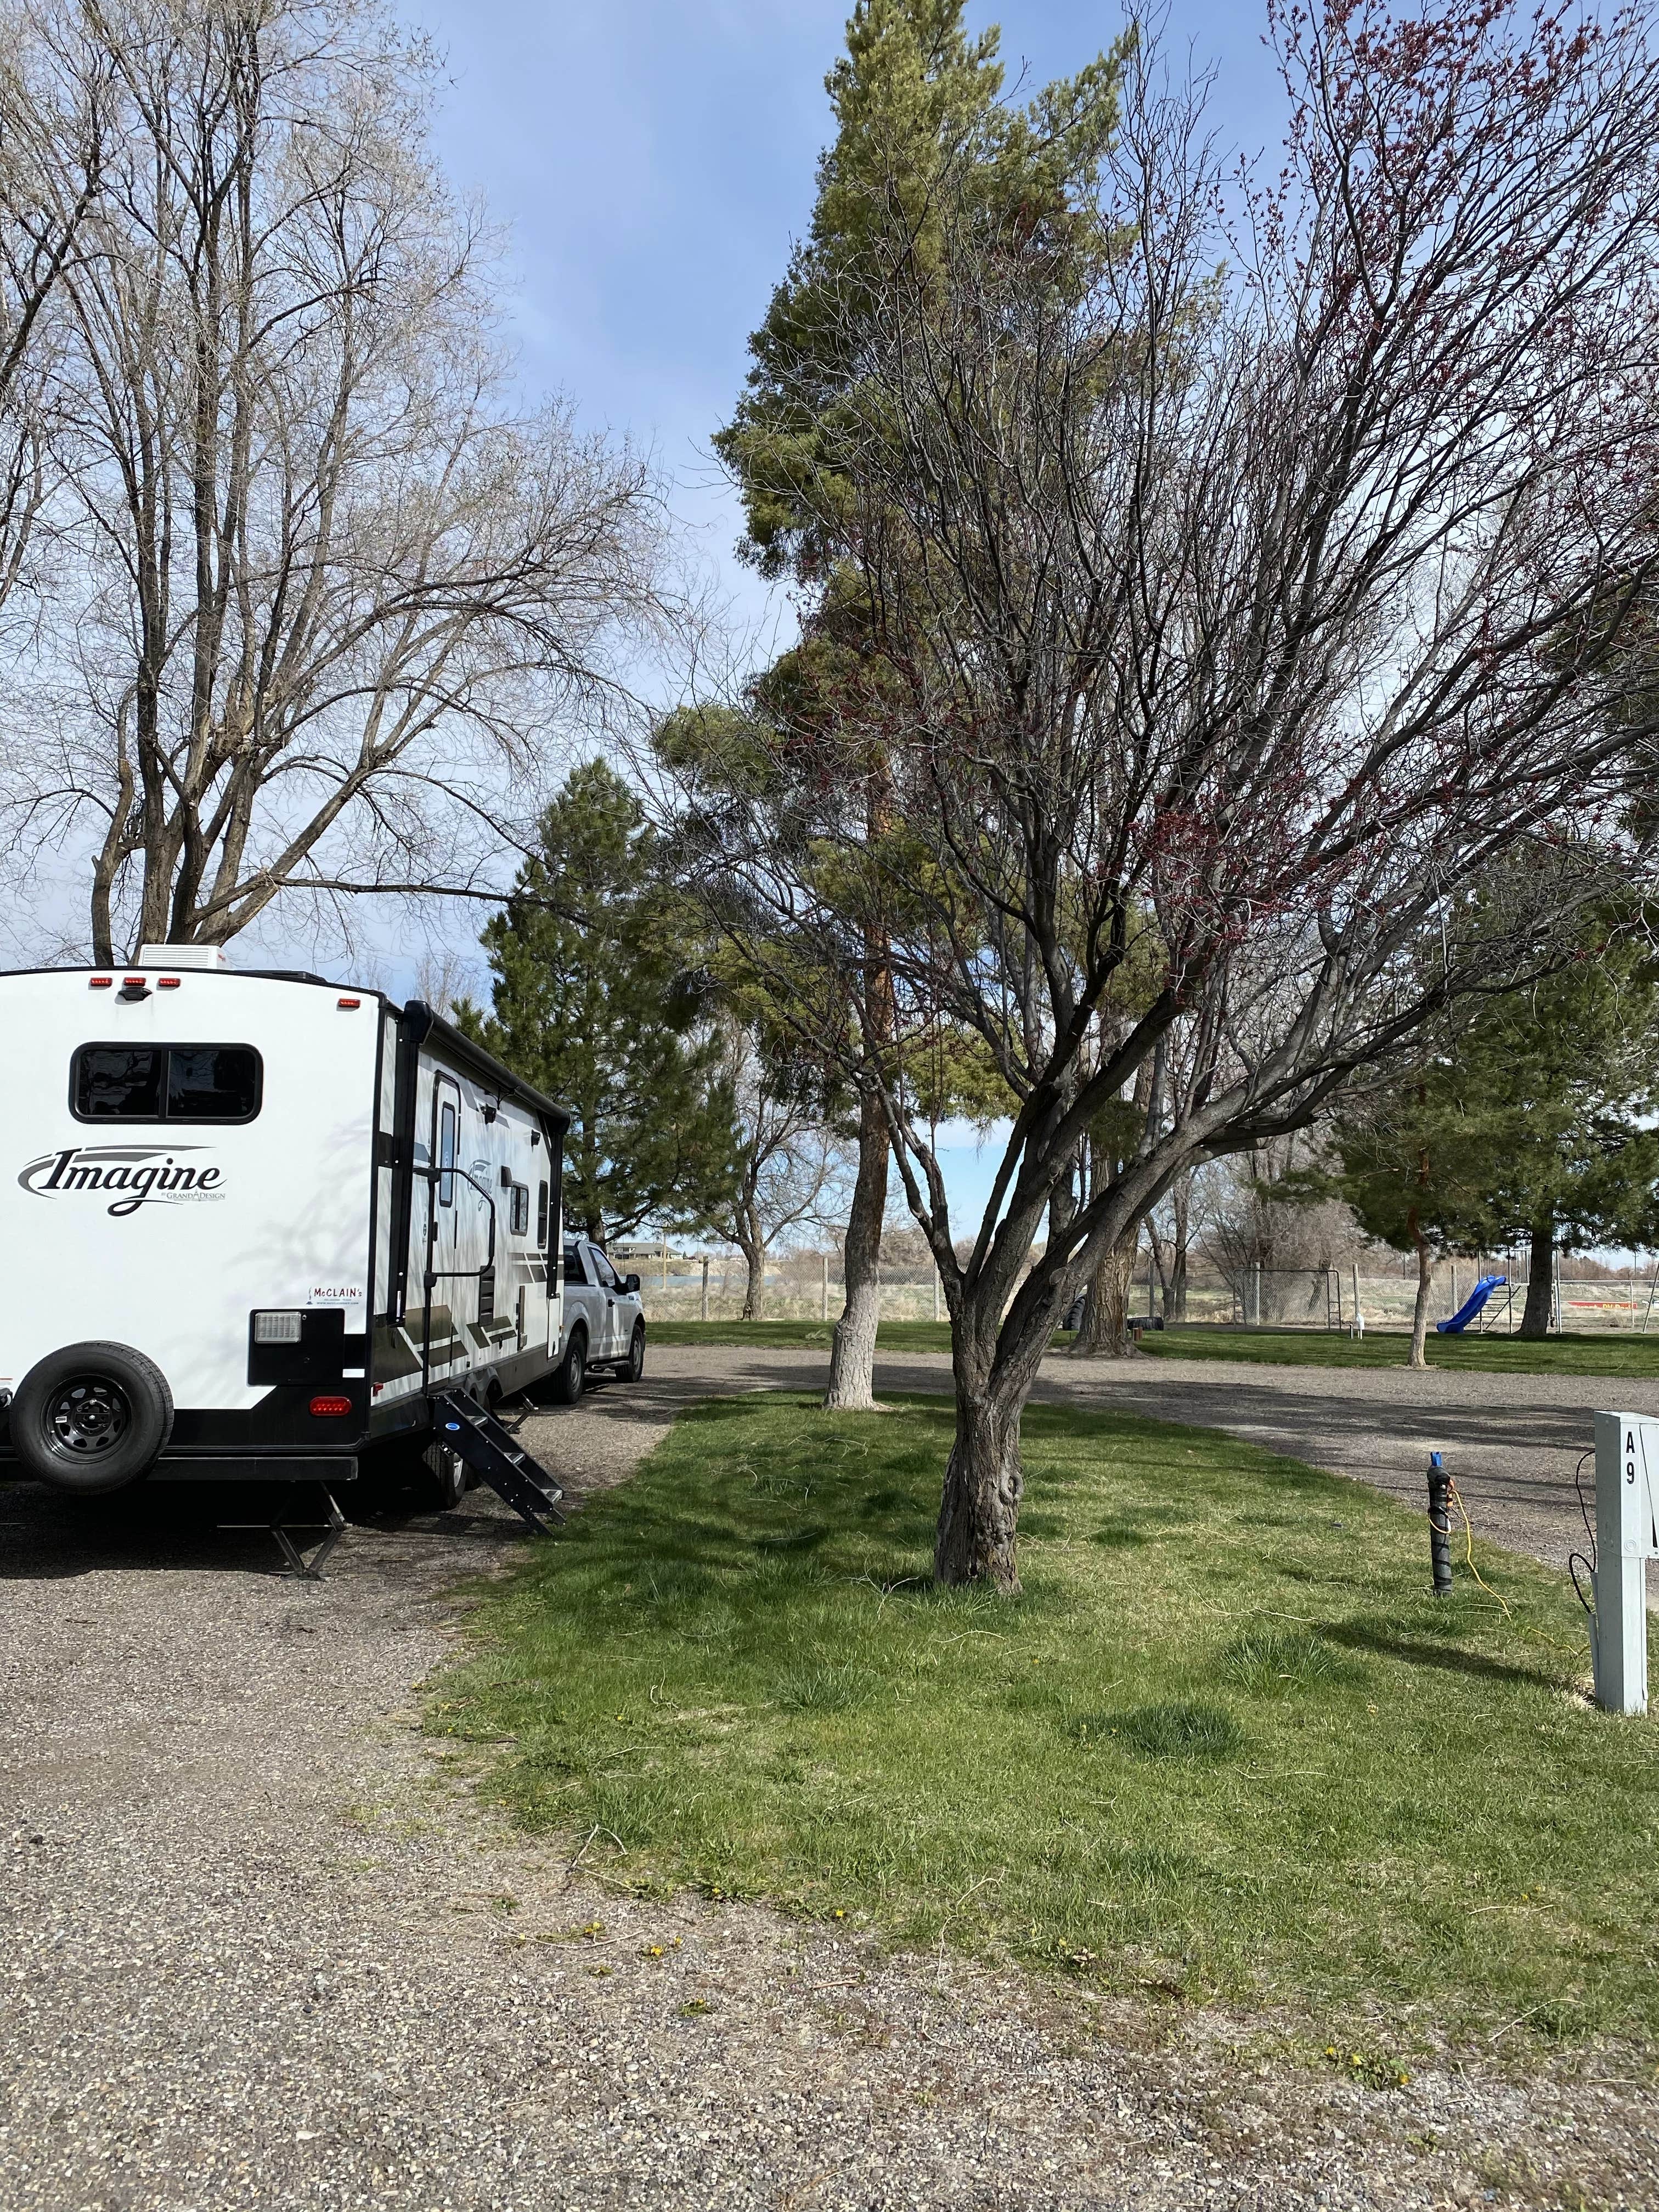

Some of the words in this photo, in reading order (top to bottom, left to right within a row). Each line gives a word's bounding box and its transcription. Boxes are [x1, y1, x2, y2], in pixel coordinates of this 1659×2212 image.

[37, 1148, 227, 1217] Imagine
[1626, 1431, 1635, 1453] A
[1627, 1462, 1635, 1485] 9
